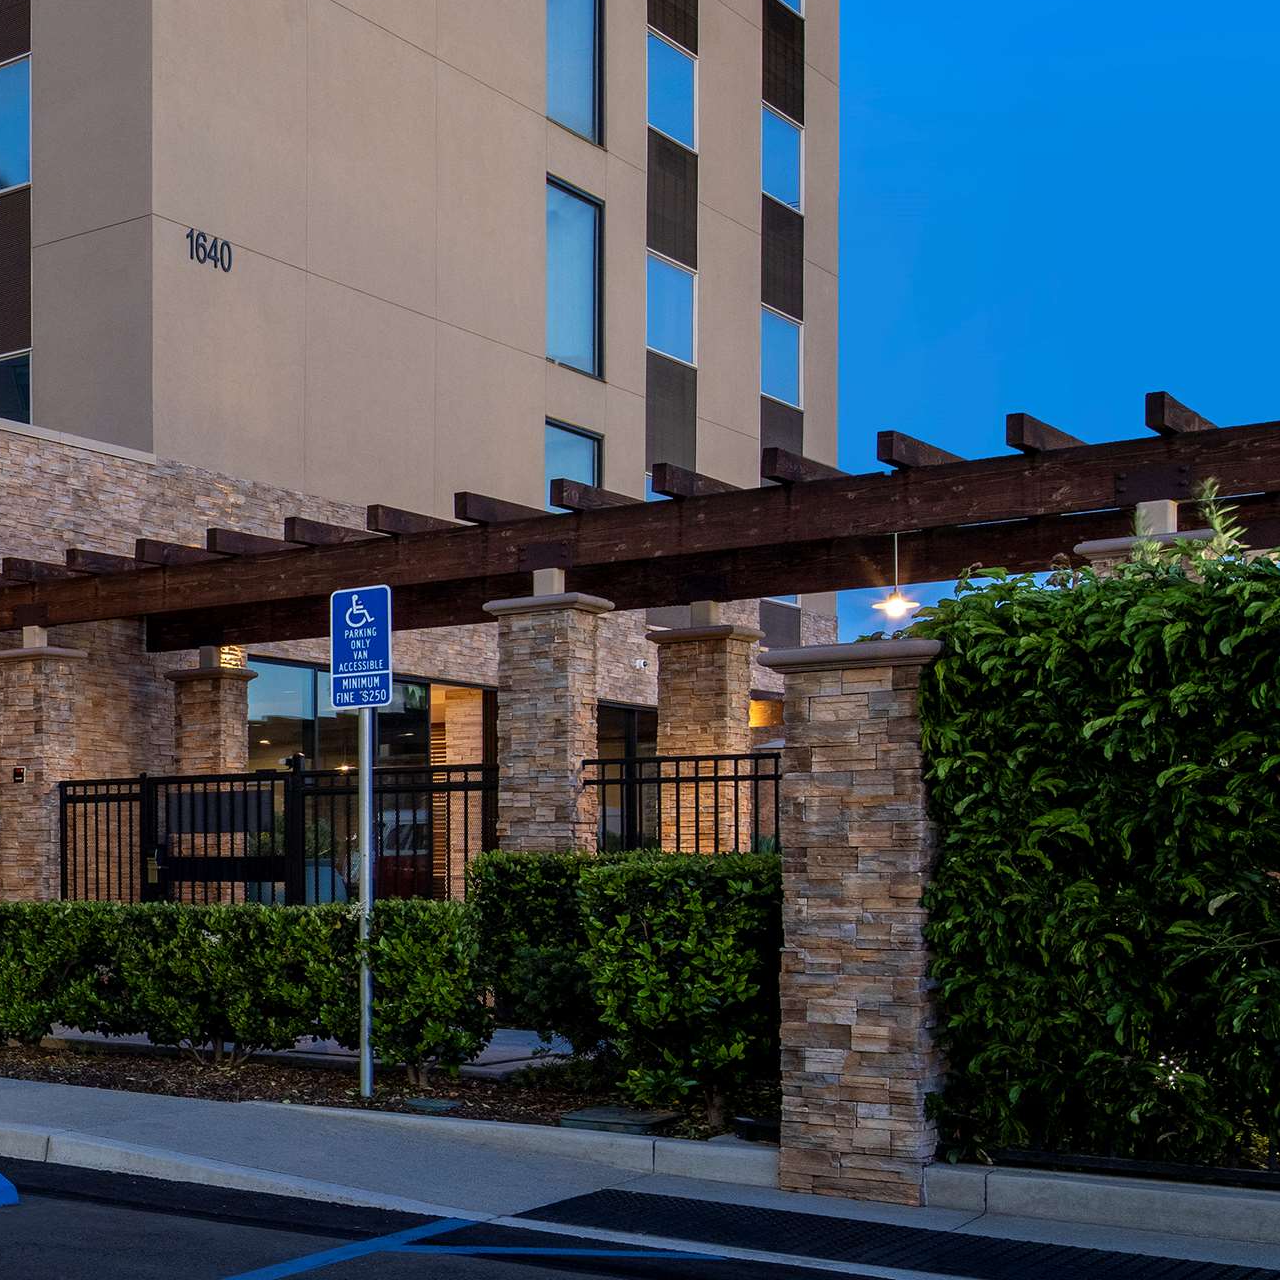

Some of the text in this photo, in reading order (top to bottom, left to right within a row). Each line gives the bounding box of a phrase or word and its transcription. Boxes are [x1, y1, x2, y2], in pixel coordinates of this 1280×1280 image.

[186, 228, 232, 273] 1640
[344, 627, 377, 639] PARKING
[350, 639, 371, 649] ONLY
[353, 650, 368, 660] VAN
[338, 660, 383, 672] ACCESSIBLE
[342, 676, 380, 689] MINIMUM
[336, 689, 387, 704] FINE $250
